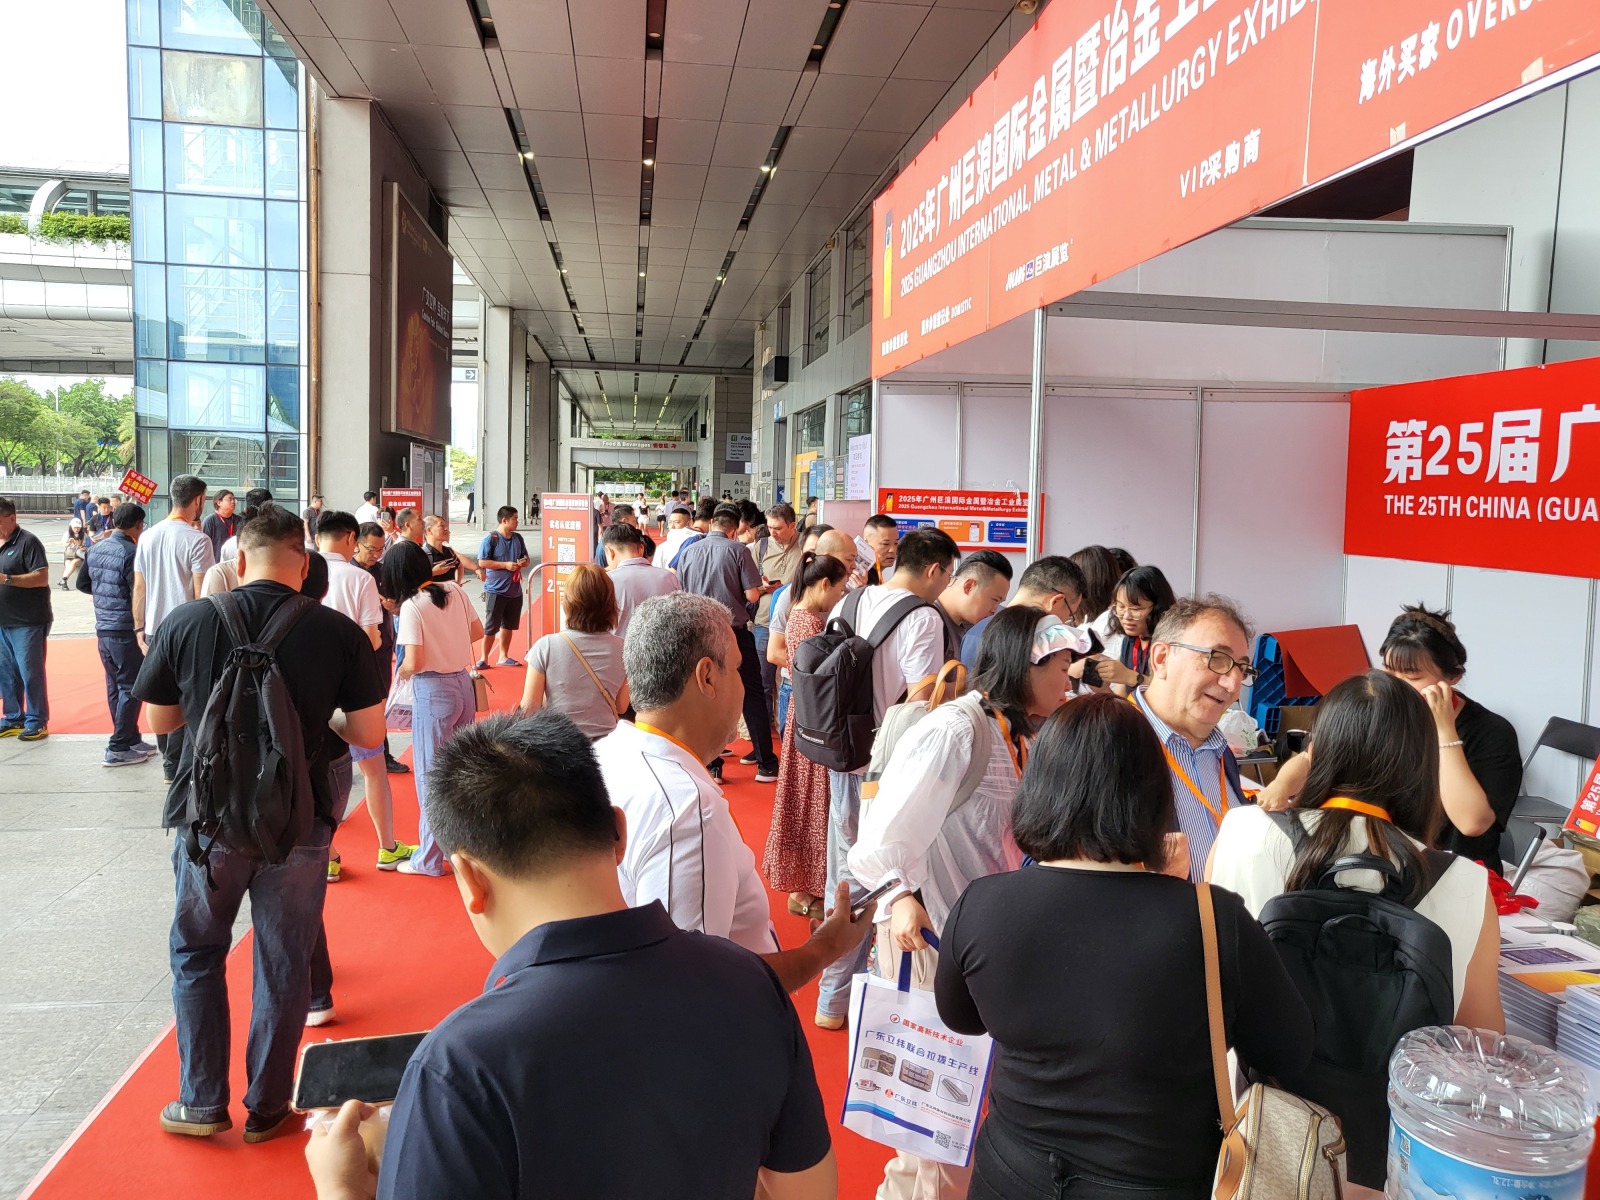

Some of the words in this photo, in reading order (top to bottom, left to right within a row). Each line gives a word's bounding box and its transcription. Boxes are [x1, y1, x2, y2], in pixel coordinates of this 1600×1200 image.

[1359, 20, 1440, 105] 海外买家
[1446, 0, 1543, 50] OVER
[900, 0, 1218, 259] 2025年广州巨浪国际金属暨冶金
[900, 276, 914, 298] 2025
[914, 239, 957, 288] GUANGZHOU
[958, 183, 1031, 259] INTERNATIONAL,
[1033, 148, 1078, 204] METAL
[1080, 137, 1092, 172] &
[1094, 30, 1222, 163] METALLURGY
[1180, 128, 1261, 198] VIP采购商
[1034, 242, 1070, 277] 巨浪展览
[623, 441, 650, 449] Beverages
[1382, 403, 1600, 484] 第25届广
[910, 504, 937, 512] Guangzhou
[1384, 494, 1415, 516] THE
[1418, 495, 1461, 518] 25TH
[1465, 496, 1531, 520] CHINA
[1537, 496, 1600, 523] (GUA
[903, 1018, 964, 1047] 国家高新技术企业
